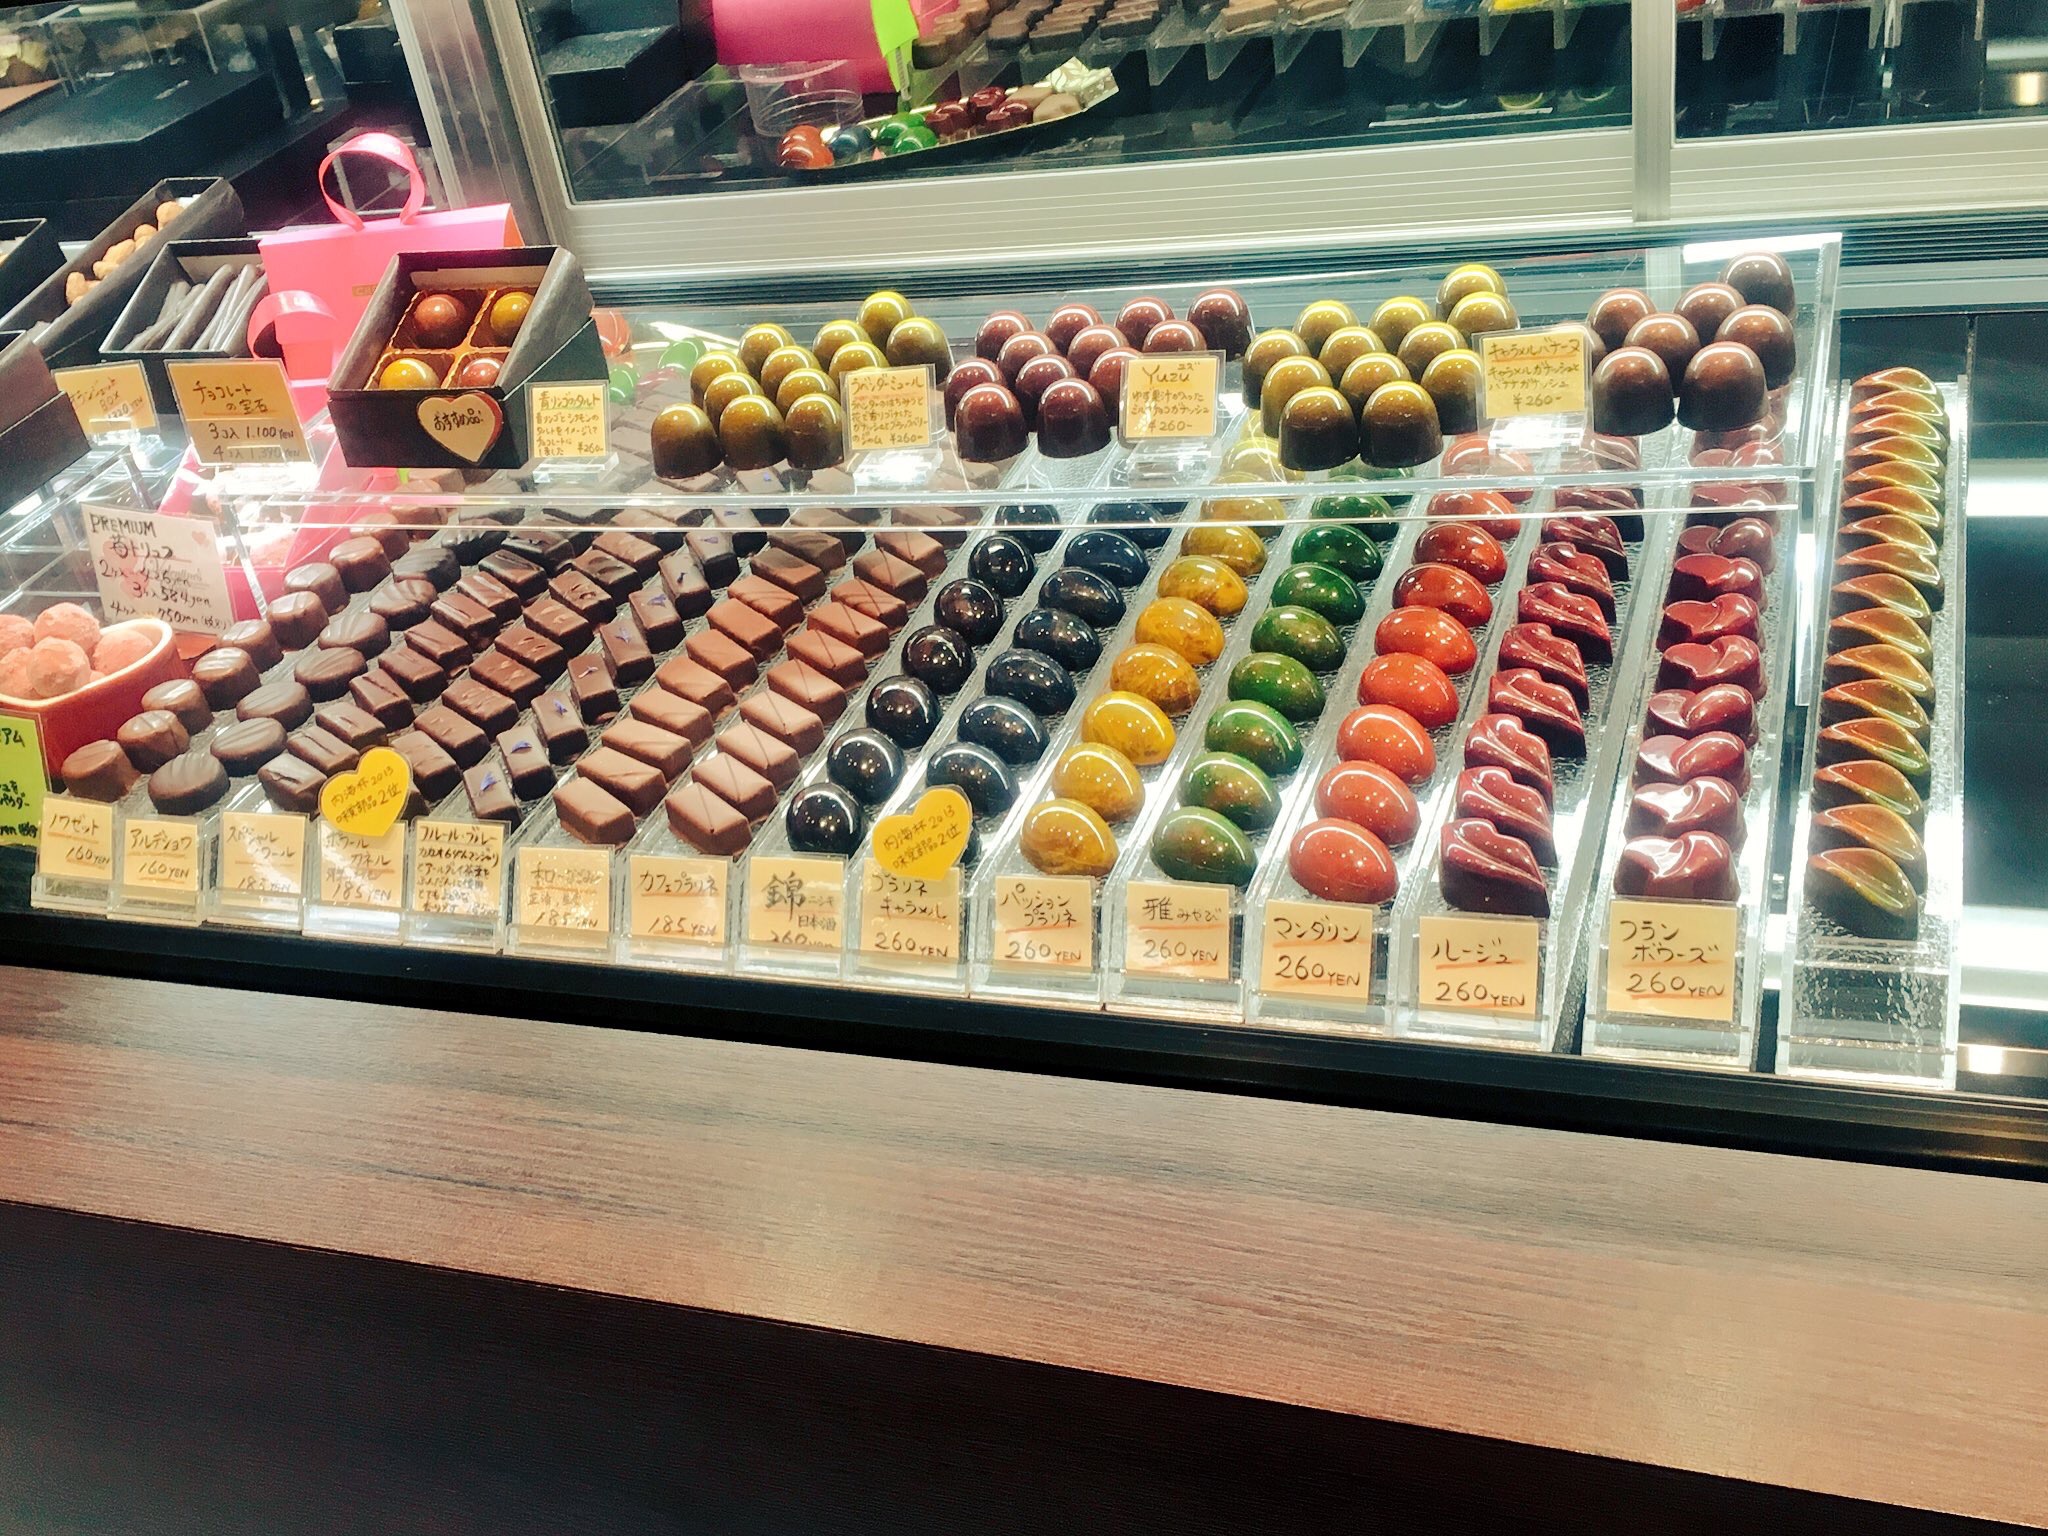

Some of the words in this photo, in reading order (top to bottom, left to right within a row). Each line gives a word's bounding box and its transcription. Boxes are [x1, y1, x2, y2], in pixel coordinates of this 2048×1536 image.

[1141, 364, 1191, 385] Yuzu
[99, 391, 119, 412] BOX
[192, 380, 252, 404] チョコレート
[226, 398, 268, 415] の宝石
[89, 512, 157, 538] PREMIUM
[49, 814, 99, 836] ノワゼット
[1000, 883, 1070, 910] パッション
[880, 896, 948, 920] キャラメル
[1024, 907, 1077, 927] プラリネ
[798, 914, 837, 932] 日本酒
[1273, 914, 1360, 943] マンダリン
[1620, 920, 1679, 942] フラン
[1431, 937, 1513, 964] ルージュ
[1631, 942, 1719, 964] ボワーズ
